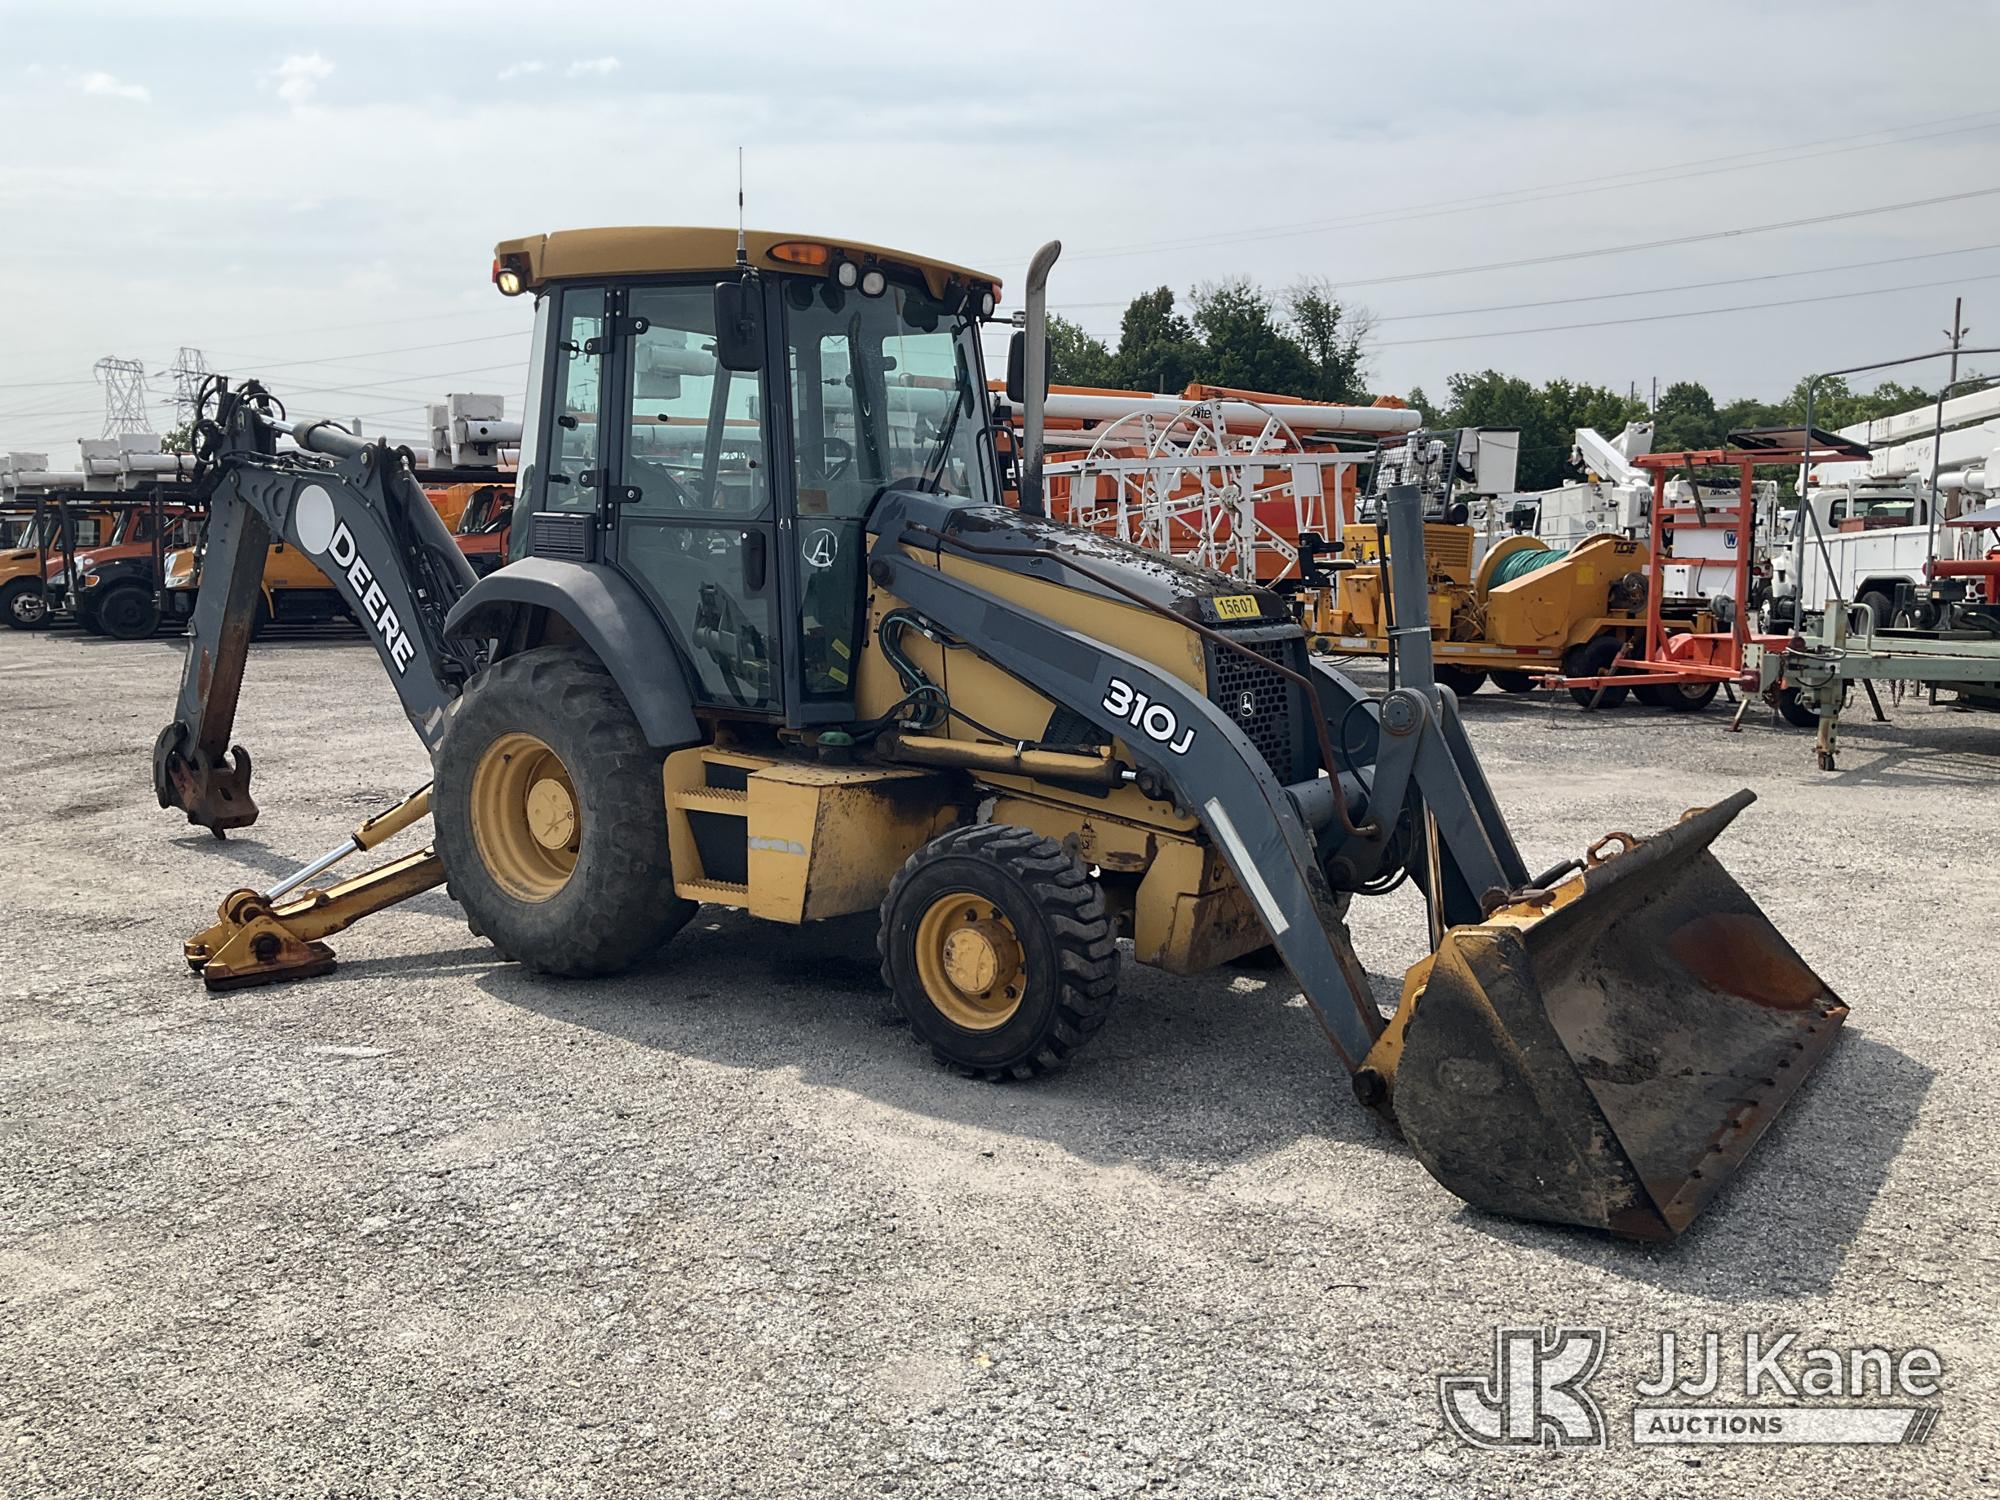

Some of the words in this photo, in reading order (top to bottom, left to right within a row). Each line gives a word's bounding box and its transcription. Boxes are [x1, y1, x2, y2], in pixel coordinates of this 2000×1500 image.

[1191, 406, 1213, 419] Alte
[328, 520, 416, 675] DEERE
[1219, 597, 1254, 615] 15607
[1102, 679, 1195, 754] 310J
